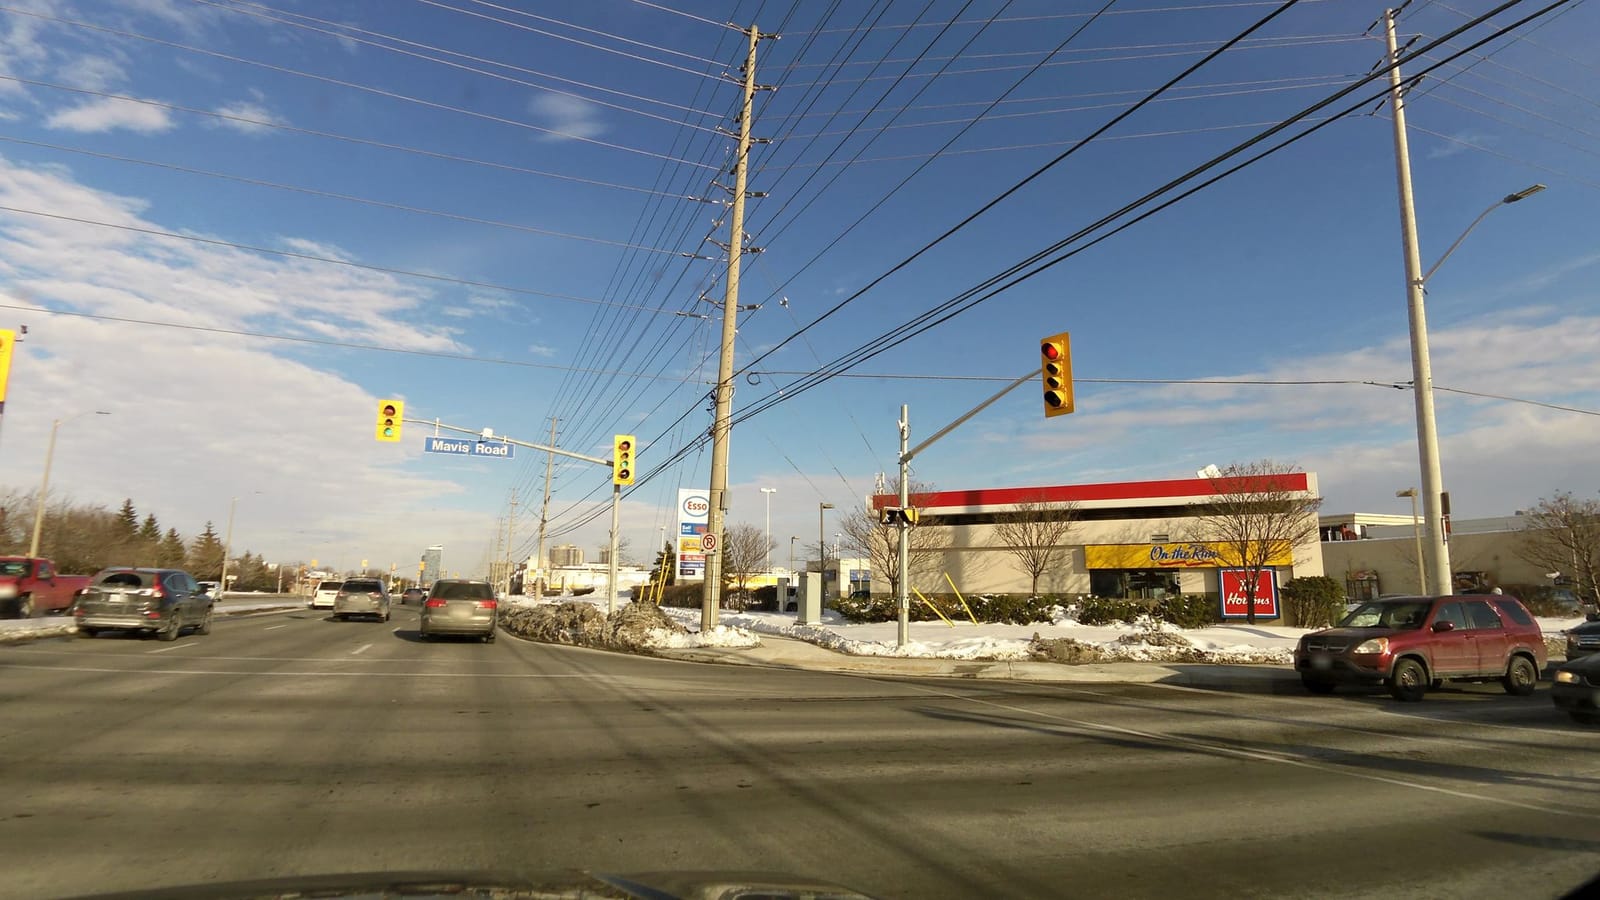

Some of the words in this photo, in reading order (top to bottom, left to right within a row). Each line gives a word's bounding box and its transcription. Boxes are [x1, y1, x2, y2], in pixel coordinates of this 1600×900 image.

[432, 440, 470, 453] Mavis
[475, 443, 508, 455] Road
[687, 501, 708, 511] Esso
[1150, 545, 1168, 561] On
[1171, 545, 1190, 560] the
[1226, 592, 1270, 605] Horns
